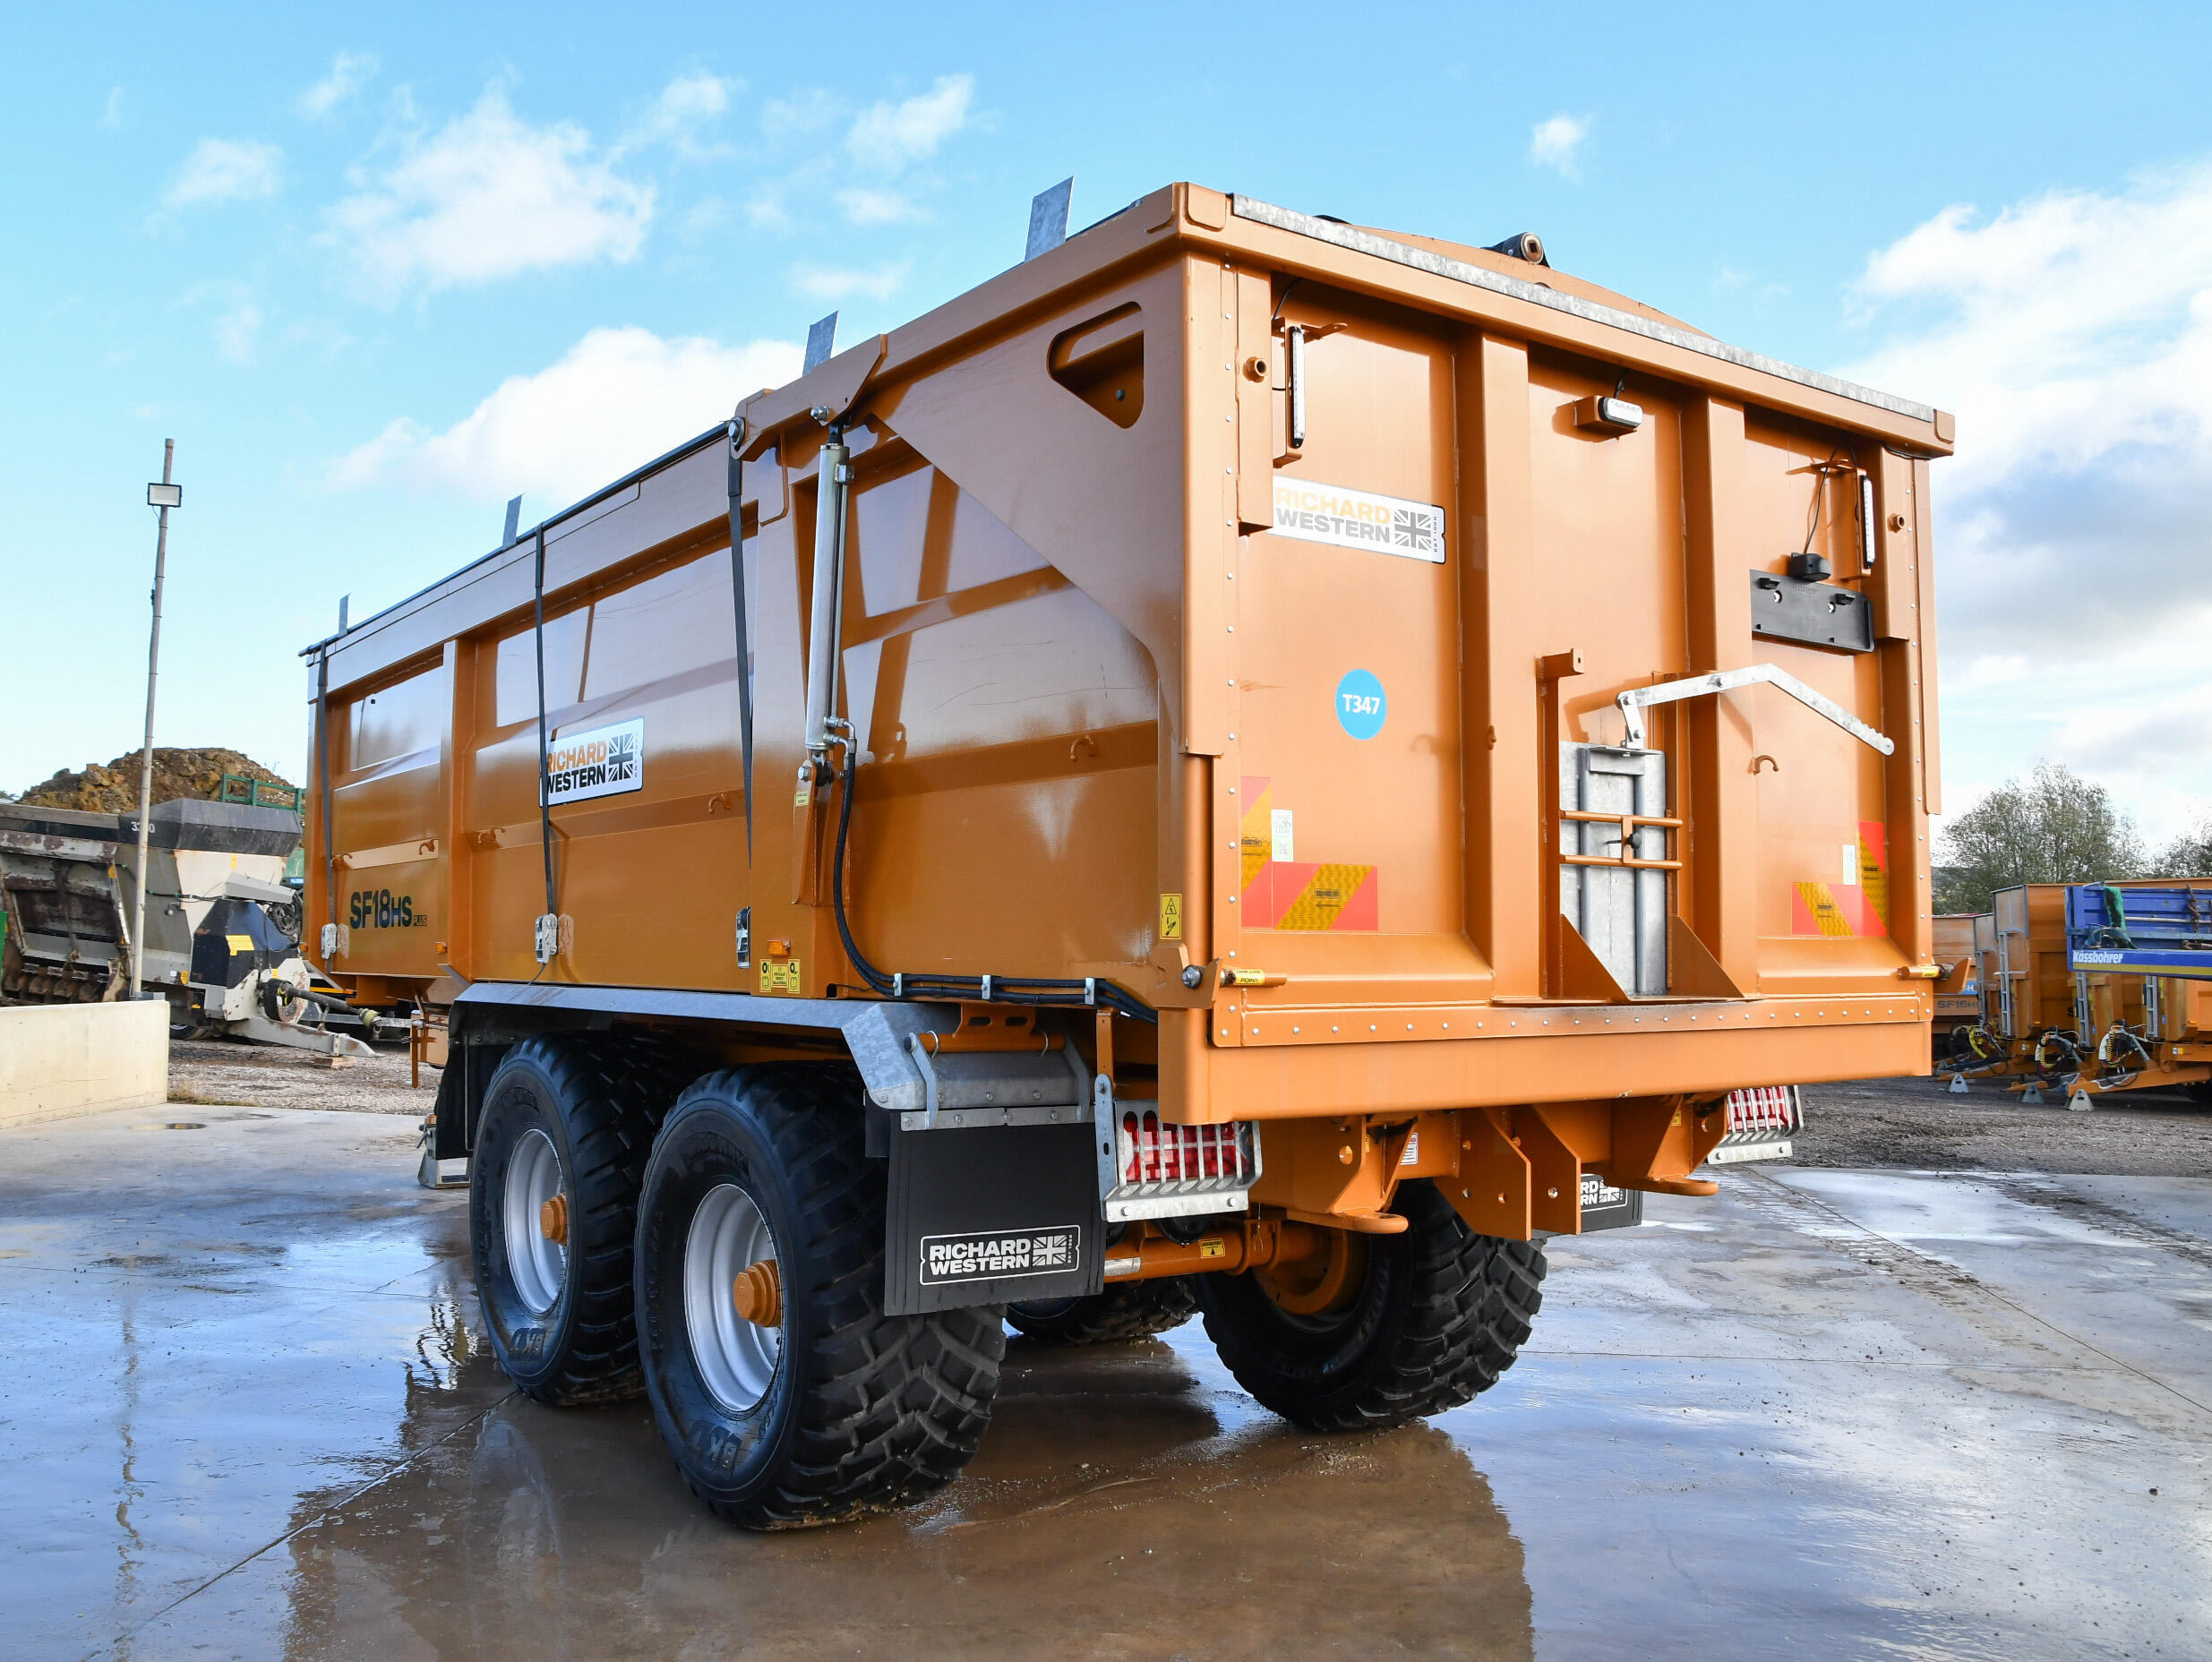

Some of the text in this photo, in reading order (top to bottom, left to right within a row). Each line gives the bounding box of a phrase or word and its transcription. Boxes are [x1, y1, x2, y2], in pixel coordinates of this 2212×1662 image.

[1275, 487, 1391, 525] RICHARD
[1276, 508, 1391, 543] WESTERN
[1342, 693, 1380, 715] T347
[350, 888, 412, 929] SF18HS
[929, 1238, 1031, 1261] RICHARD
[930, 1254, 1030, 1275] WESTERN
